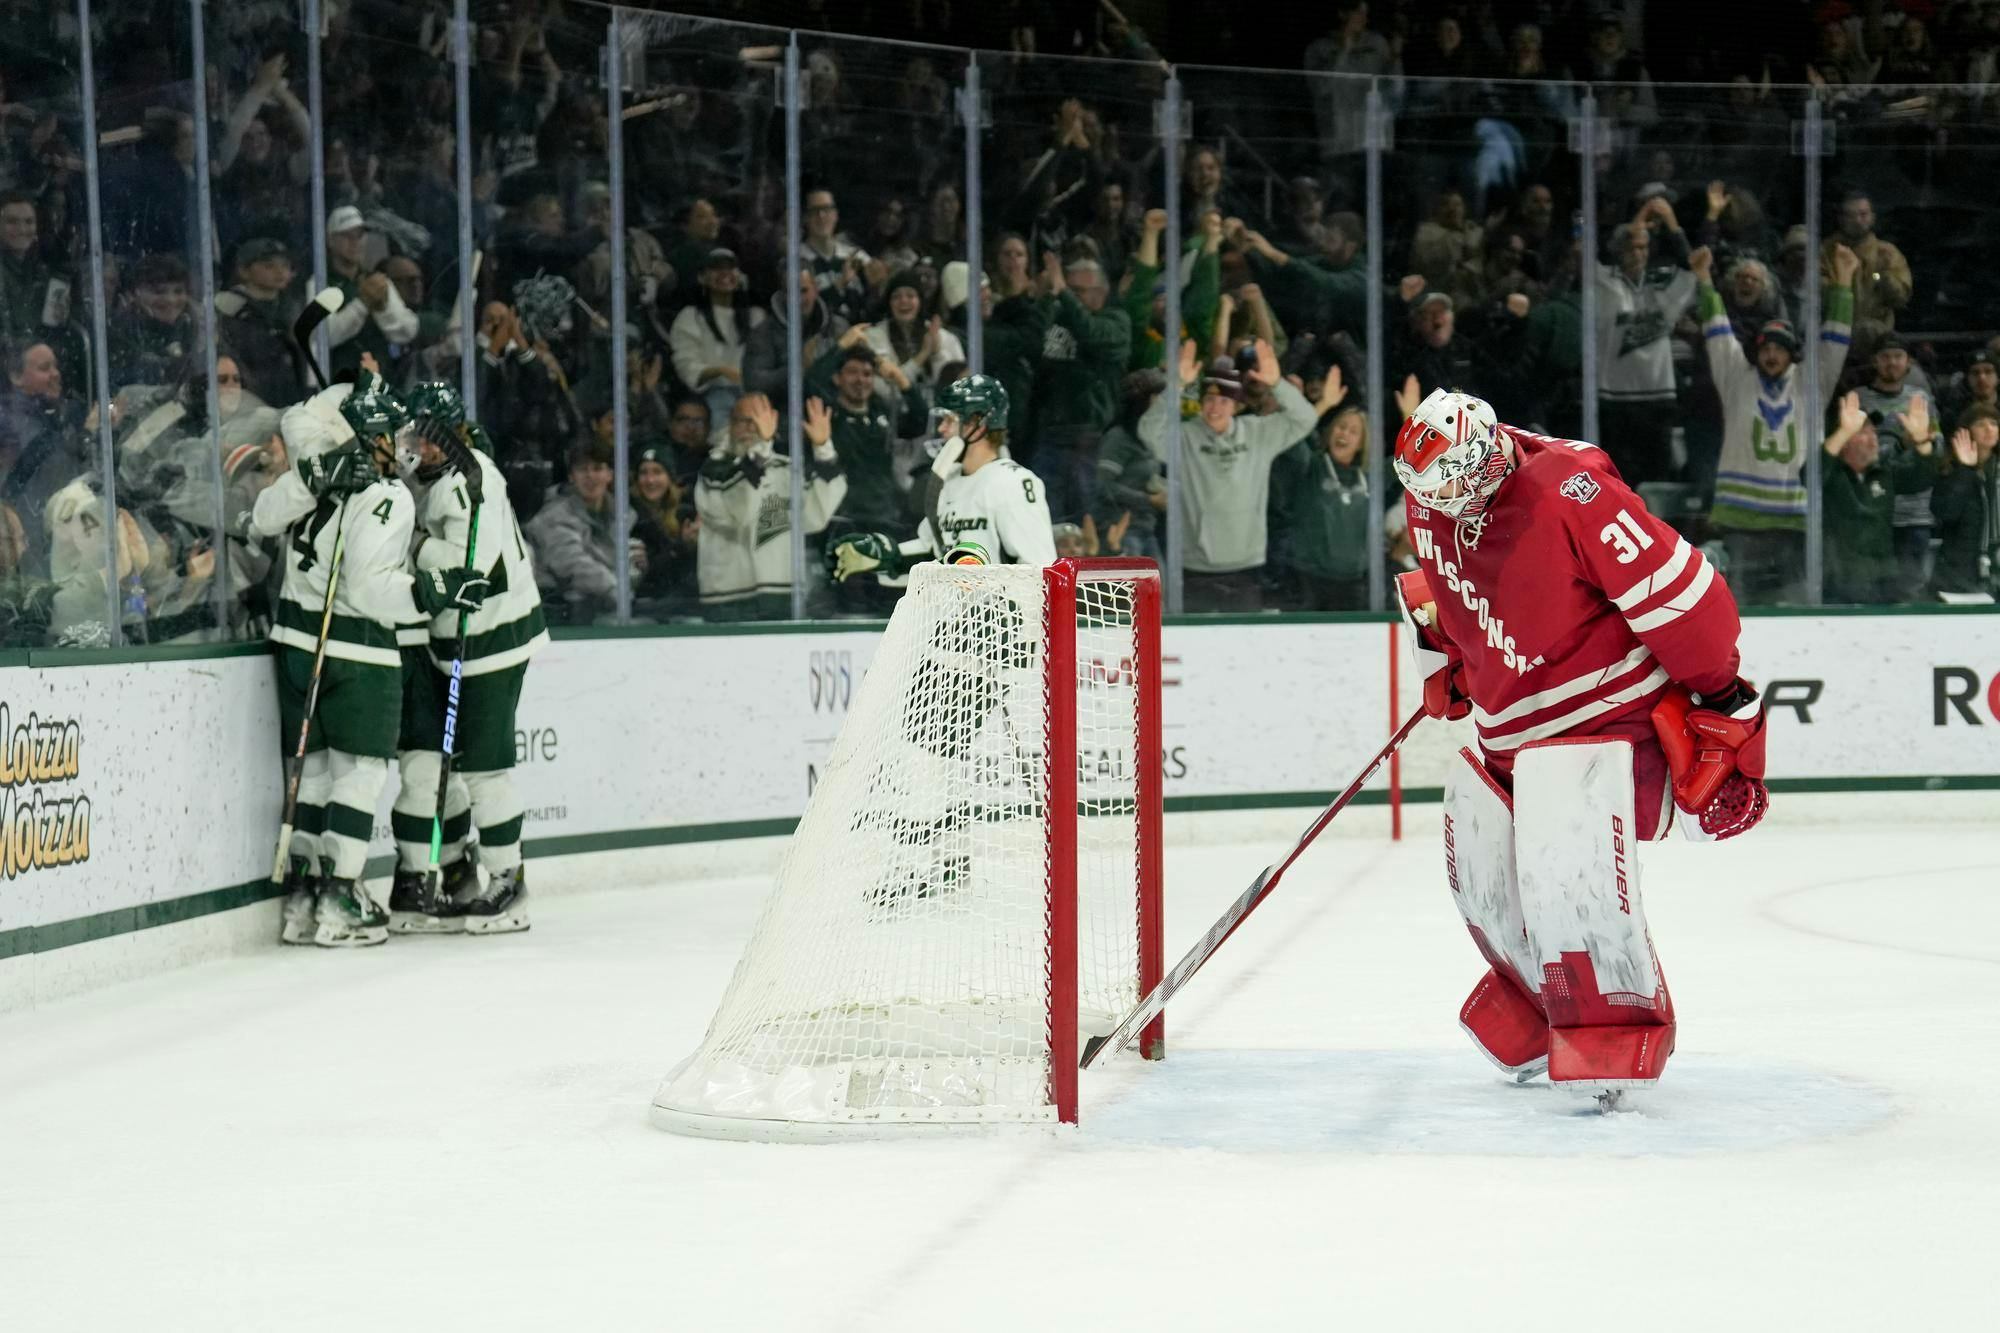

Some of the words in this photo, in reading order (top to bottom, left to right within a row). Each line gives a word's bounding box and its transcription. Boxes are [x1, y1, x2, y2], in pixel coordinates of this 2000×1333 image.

[372, 498, 393, 525] 4
[1023, 479, 1035, 503] 8
[1600, 509, 1654, 564] 31
[0, 701, 80, 788] Lotzza
